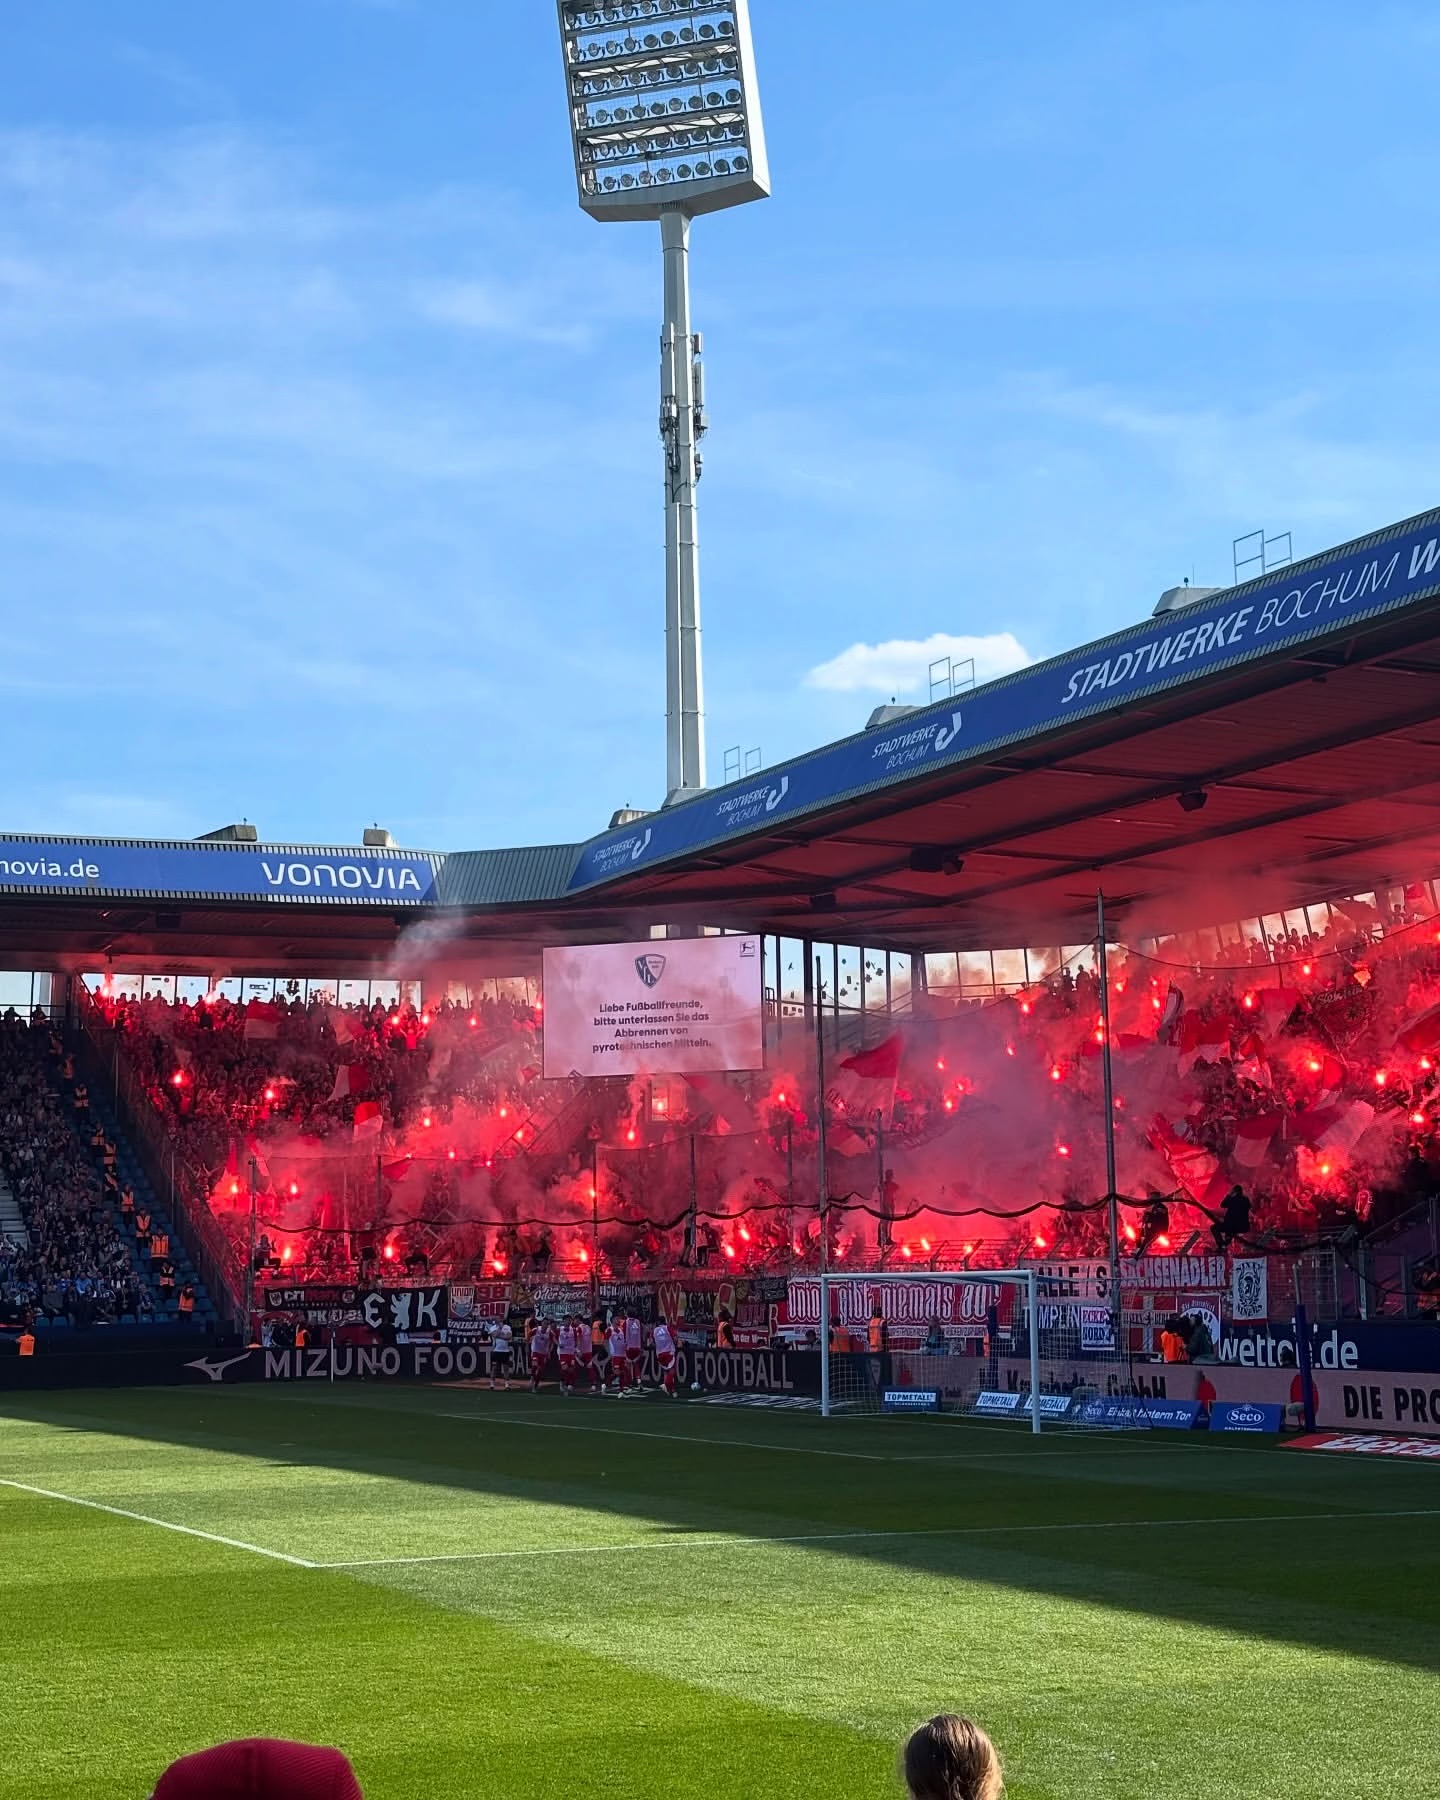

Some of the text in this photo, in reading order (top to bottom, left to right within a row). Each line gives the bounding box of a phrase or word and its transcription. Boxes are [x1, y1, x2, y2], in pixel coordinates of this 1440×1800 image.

[1061, 606, 1254, 704] STADTWERKE
[1254, 552, 1400, 634] BOCHUM
[871, 723, 938, 759] STADTWERKE
[886, 743, 930, 770] BOCHUM
[594, 1011, 709, 1026] bitte unterlassen Sie das
[600, 1000, 703, 1013] Liebe Fußballfreunde,
[614, 1026, 688, 1038] Abbrennen von
[592, 1039, 672, 1054] pyrotehnischen
[1120, 1255, 1227, 1288] SACHSENADLER
[787, 1280, 830, 1323] Unio
[1023, 1306, 1081, 1330] TMPLIN
[264, 1347, 401, 1378] MIZUNO
[694, 1351, 794, 1389] FOOTBALL
[887, 1393, 931, 1402] TOPMETALL
[1343, 1385, 1383, 1420] DIE
[1175, 1410, 1191, 1421] Tor
[1230, 1410, 1262, 1422] Seco
